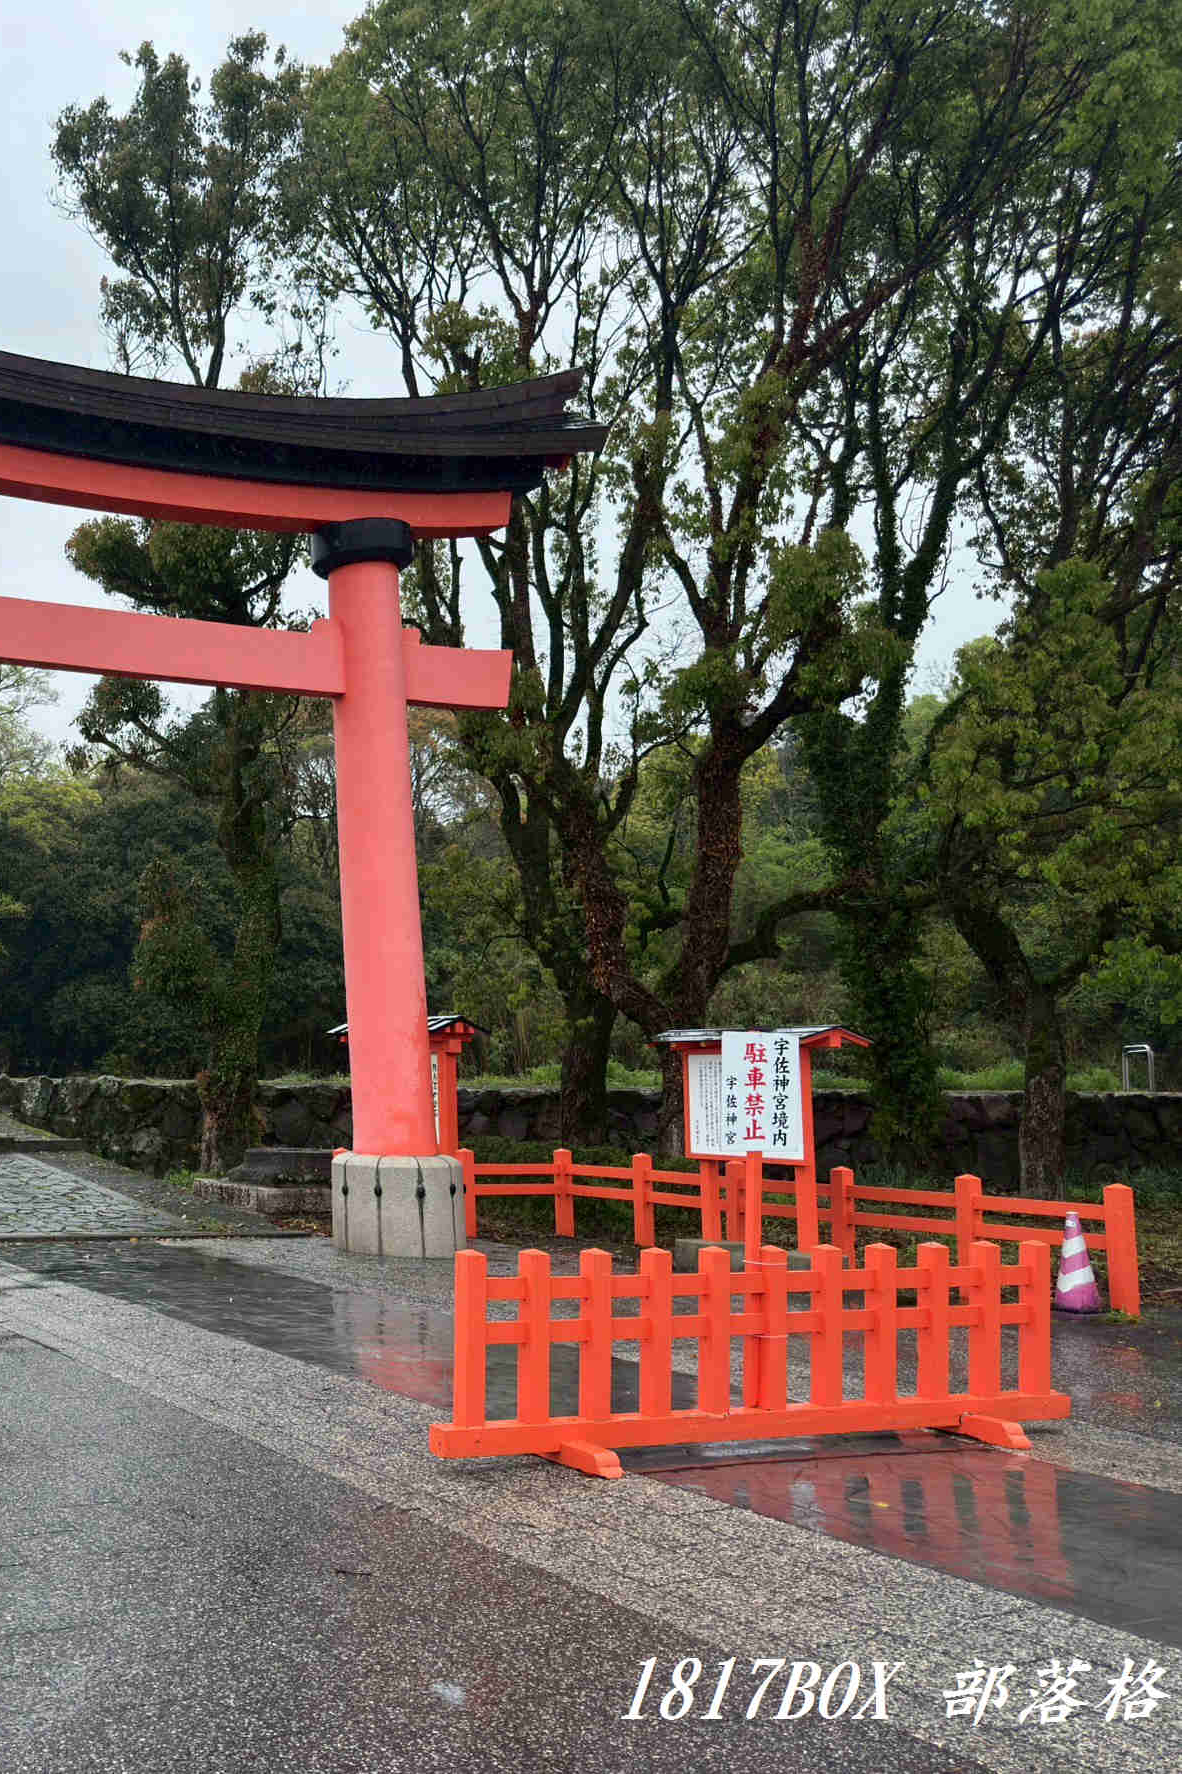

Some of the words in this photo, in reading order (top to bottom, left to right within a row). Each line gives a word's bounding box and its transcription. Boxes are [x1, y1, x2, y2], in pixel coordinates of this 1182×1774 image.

[725, 1075, 738, 1145] 宇佐神宮
[742, 1042, 768, 1141] 駐車禁止
[772, 1037, 790, 1147] 宇佐神宮境内
